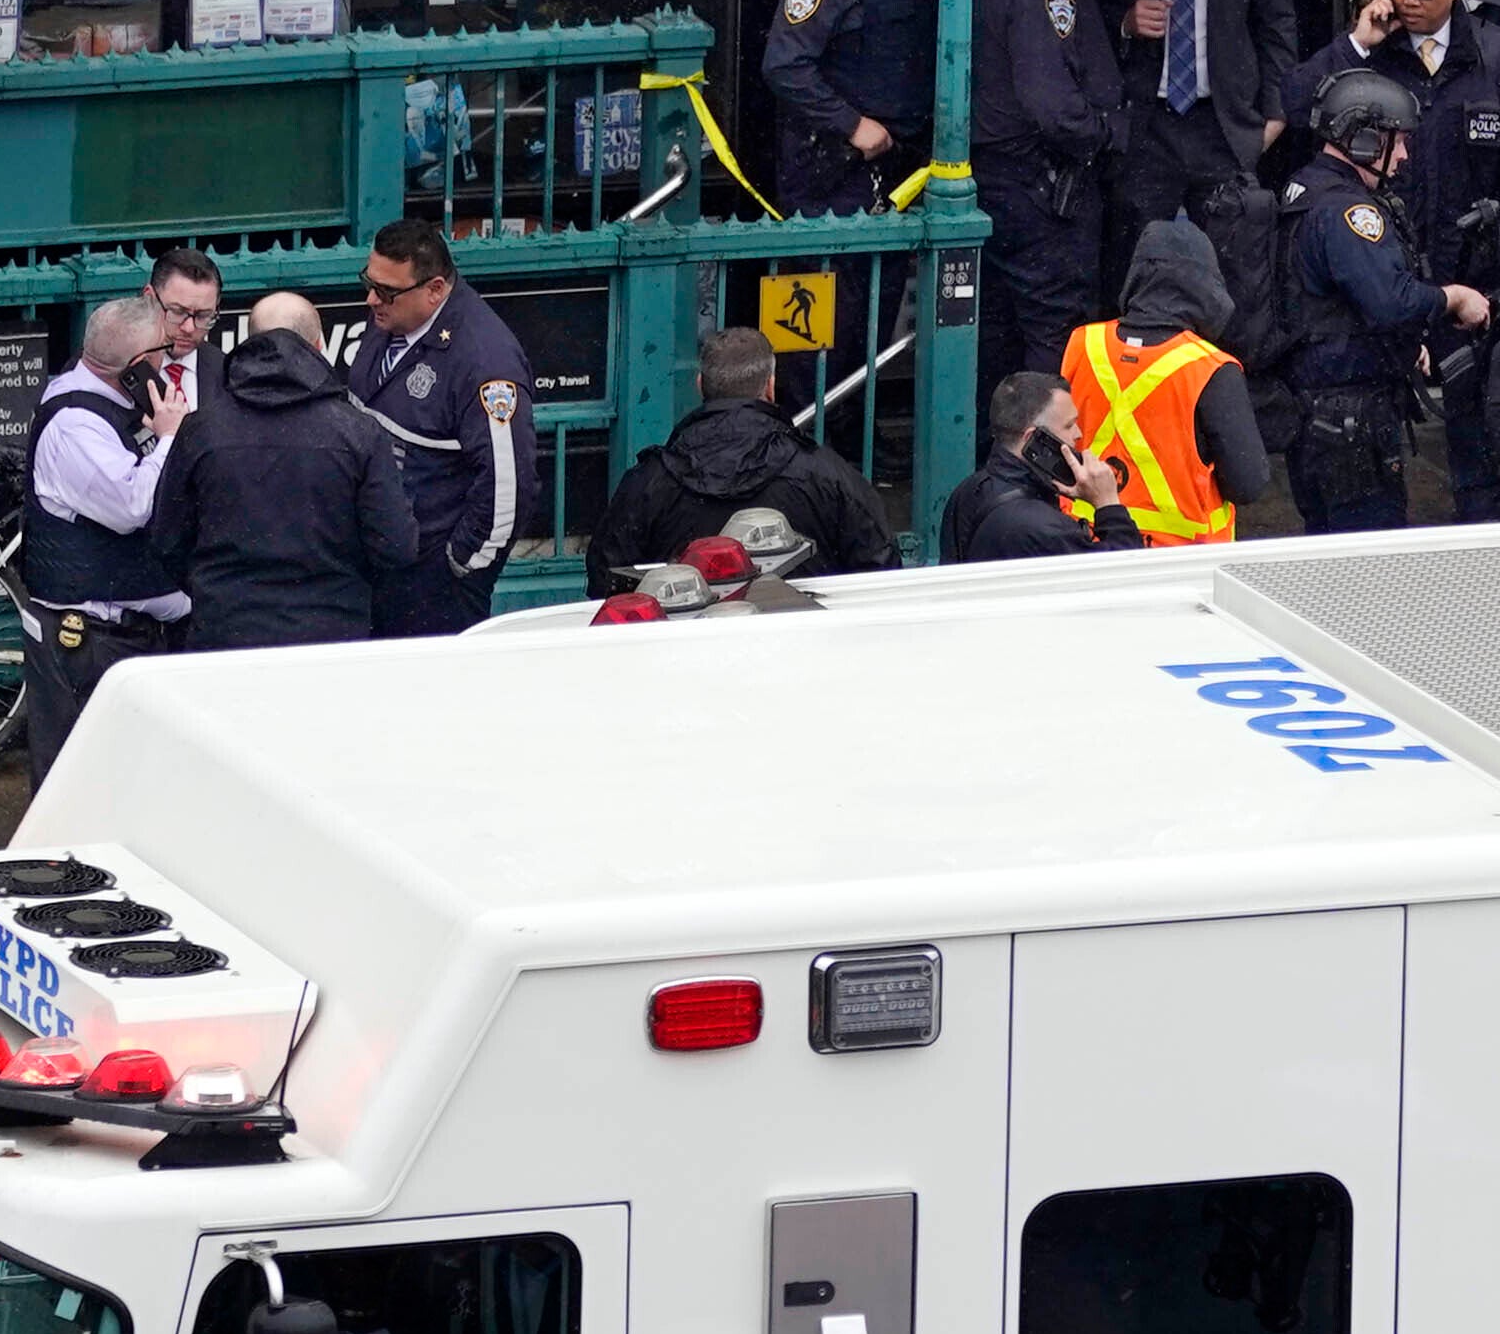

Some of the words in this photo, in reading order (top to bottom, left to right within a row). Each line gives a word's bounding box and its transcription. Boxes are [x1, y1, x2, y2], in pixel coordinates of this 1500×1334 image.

[23, 357, 43, 370] will
[26, 375, 40, 387] to
[535, 377, 555, 389] City
[558, 375, 590, 387] Transit
